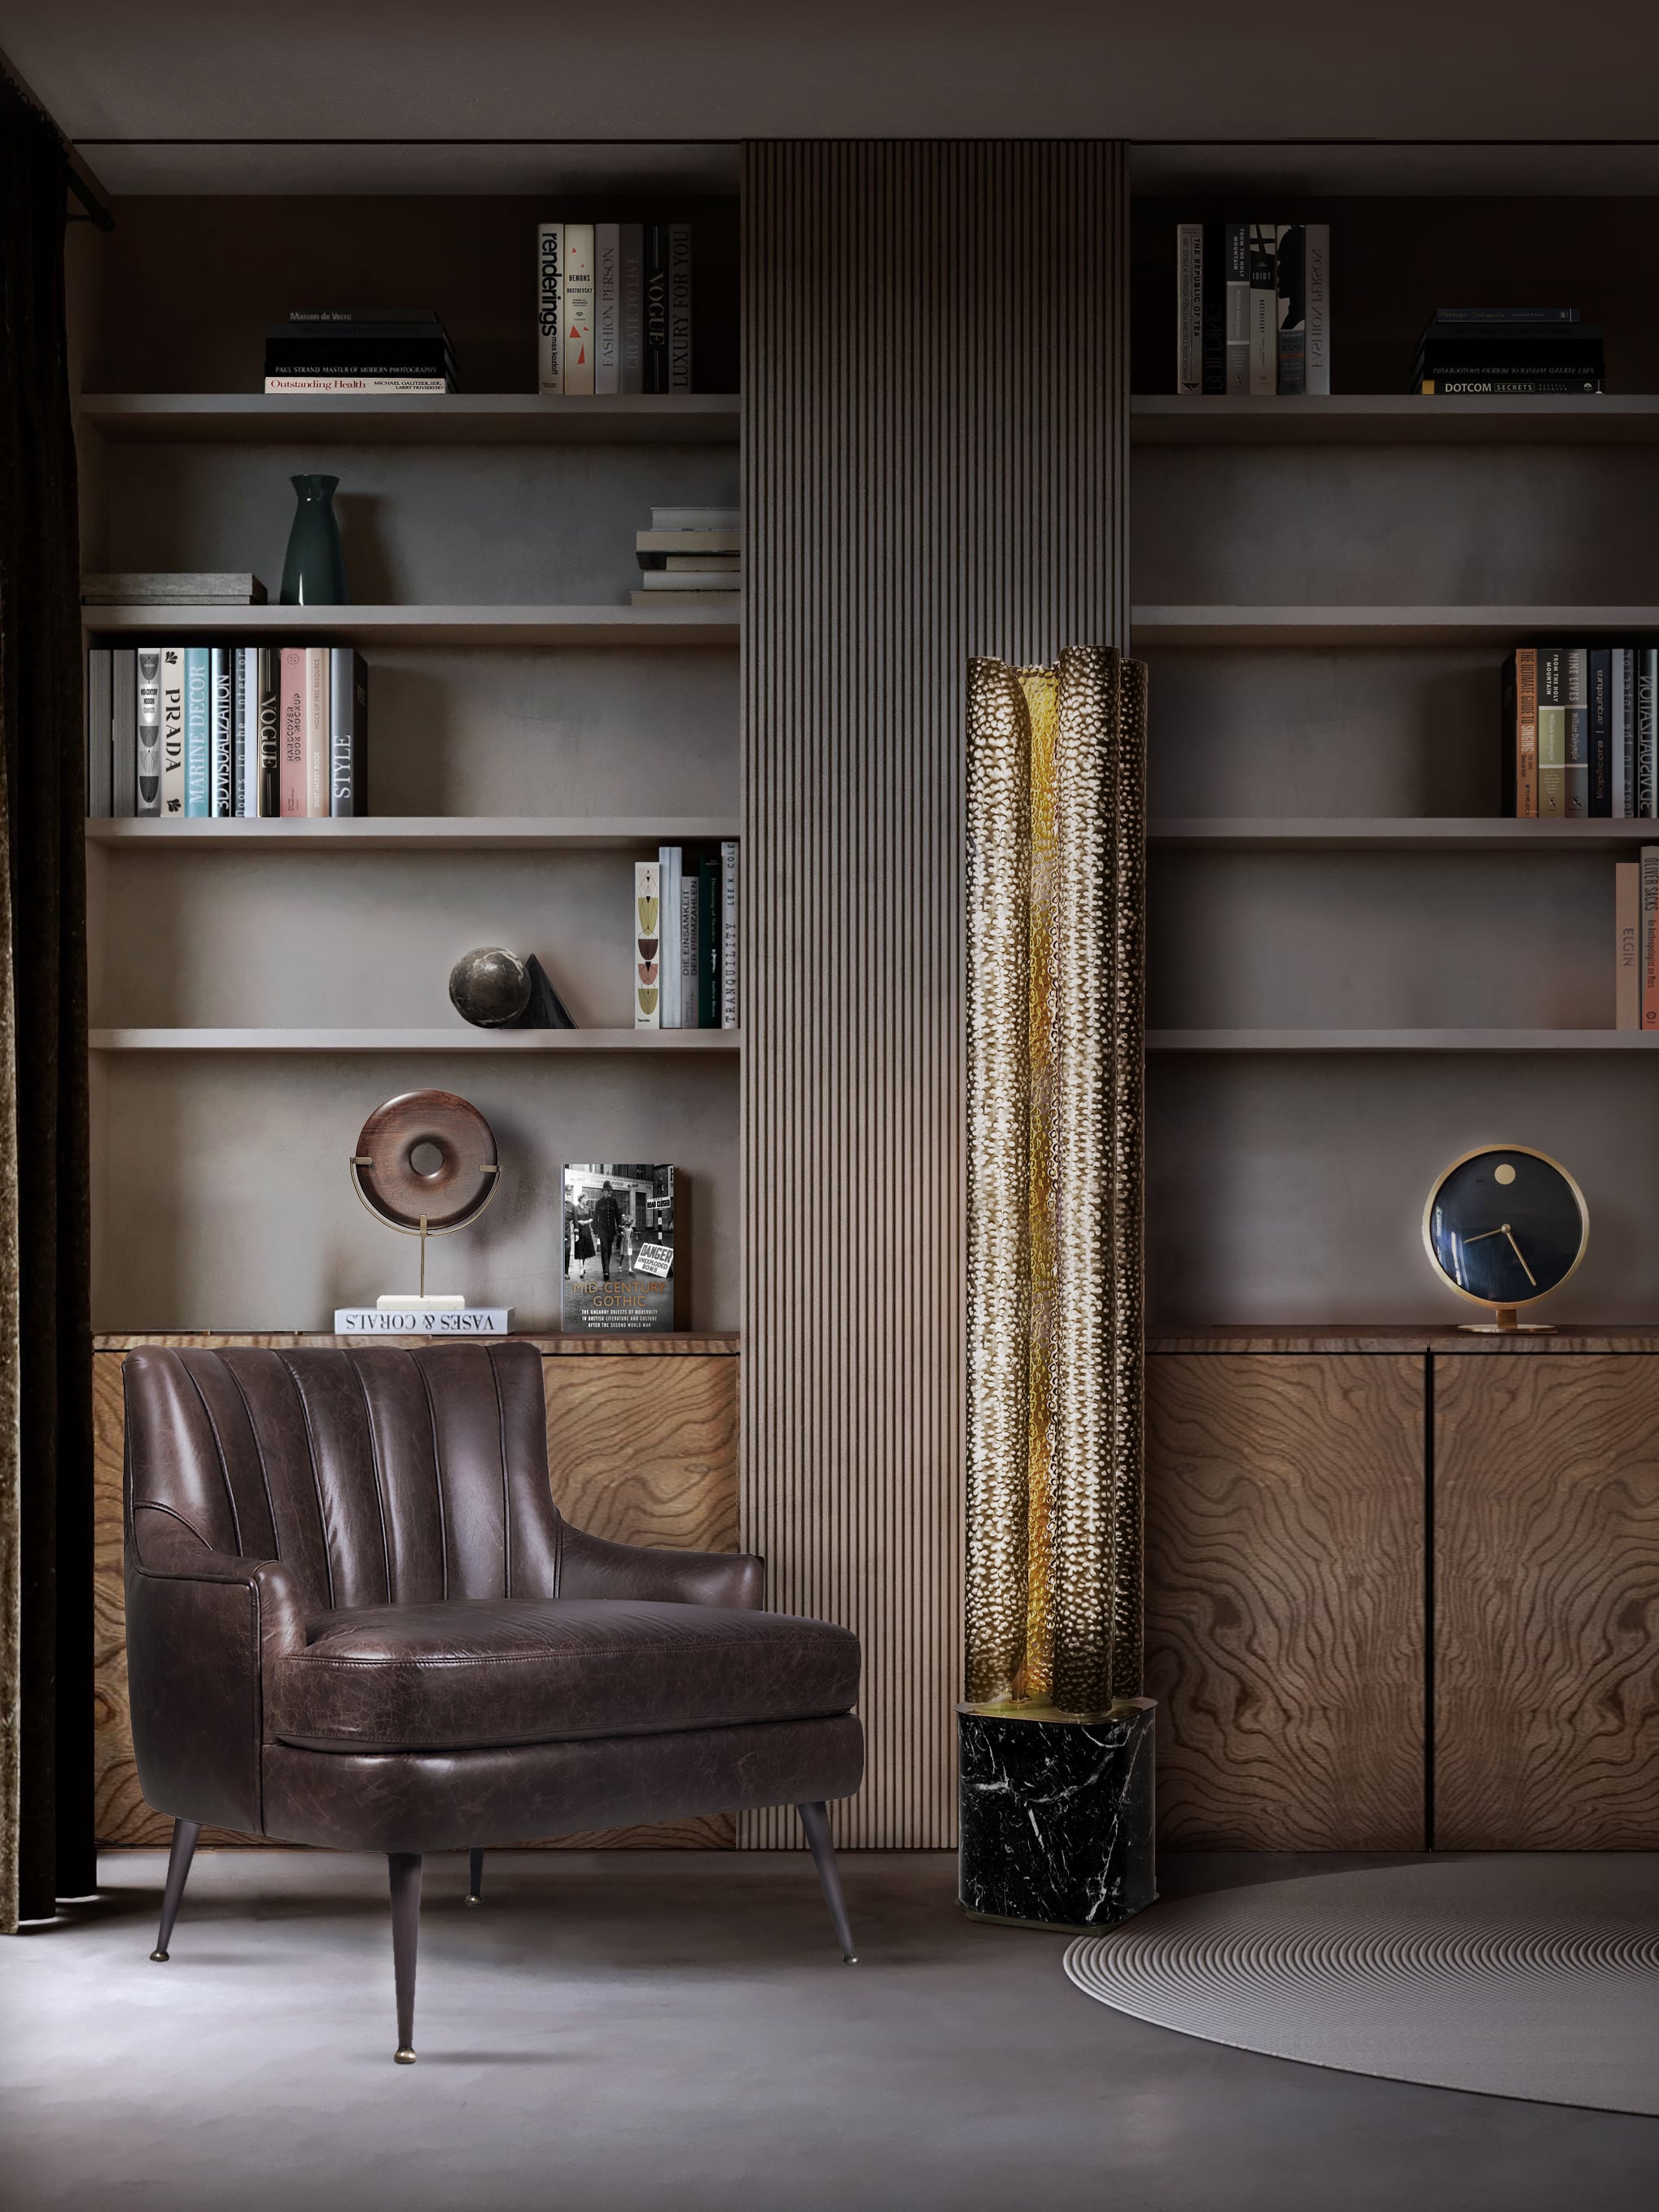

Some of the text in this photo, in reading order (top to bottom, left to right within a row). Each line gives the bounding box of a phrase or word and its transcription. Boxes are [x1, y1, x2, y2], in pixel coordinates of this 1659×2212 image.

[540, 234, 562, 336] renderings
[1252, 272, 1271, 280] IDIOT
[602, 247, 614, 366] FASHION PERSON
[649, 271, 665, 345] VOGUE
[673, 230, 689, 387] LUXURY FOR YOU
[1193, 307, 1200, 318] OF
[271, 379, 366, 390] Outstanding Health
[1445, 383, 1492, 392] DOTCOM
[1521, 651, 1534, 663] THE
[1521, 664, 1534, 694] ULTIMATE
[1569, 653, 1578, 701] NINE LIVES
[1521, 696, 1534, 714] GUIDE
[1596, 670, 1604, 725] arquitetura
[165, 689, 182, 773] PRADA
[189, 665, 205, 804] MARINE DECOR
[216, 675, 229, 809] 3D VISUALIZATION
[235, 723, 244, 743] the
[260, 695, 277, 769] VOGUE
[1569, 712, 1579, 760] William Dalrymple
[334, 734, 351, 799] STYLE
[1644, 857, 1658, 911] OLIVER SACKS
[1623, 928, 1635, 966] ELGIN
[1645, 927, 1656, 967] Anthropologist
[725, 923, 737, 1023] TRANQUILITY
[1648, 975, 1657, 988] Mars
[657, 1199, 670, 1207] CLOSED
[638, 1257, 668, 1270] UNEXPLODED
[640, 1245, 672, 1263] DANGER
[642, 1264, 658, 1272] BOMB
[573, 1282, 666, 1294] MID-CENTURY
[593, 1295, 646, 1307] GOTHIC
[346, 1315, 494, 1330] VASES & CORALS
